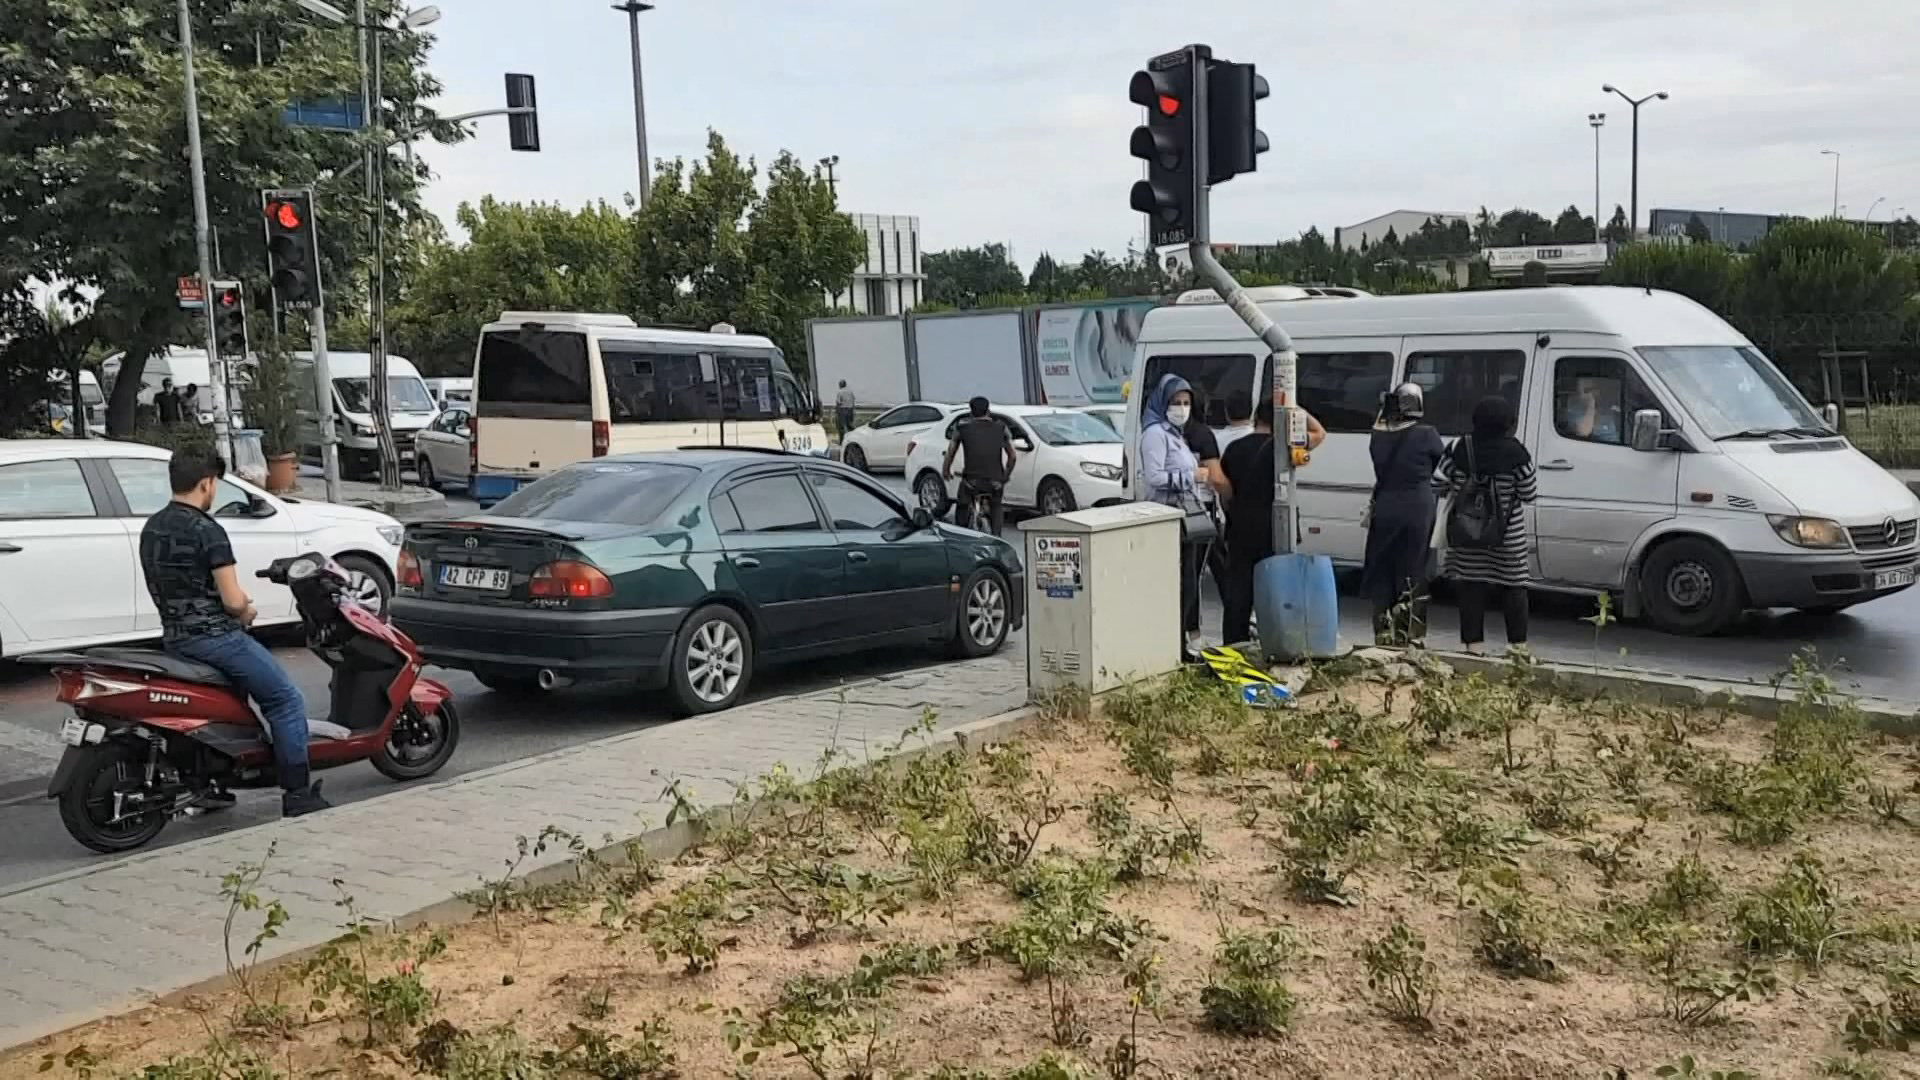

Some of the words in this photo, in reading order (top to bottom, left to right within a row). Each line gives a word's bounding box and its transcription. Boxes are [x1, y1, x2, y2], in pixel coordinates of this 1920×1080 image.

[446, 568, 459, 585] 42
[465, 570, 487, 584] CFP
[492, 574, 507, 588] 89
